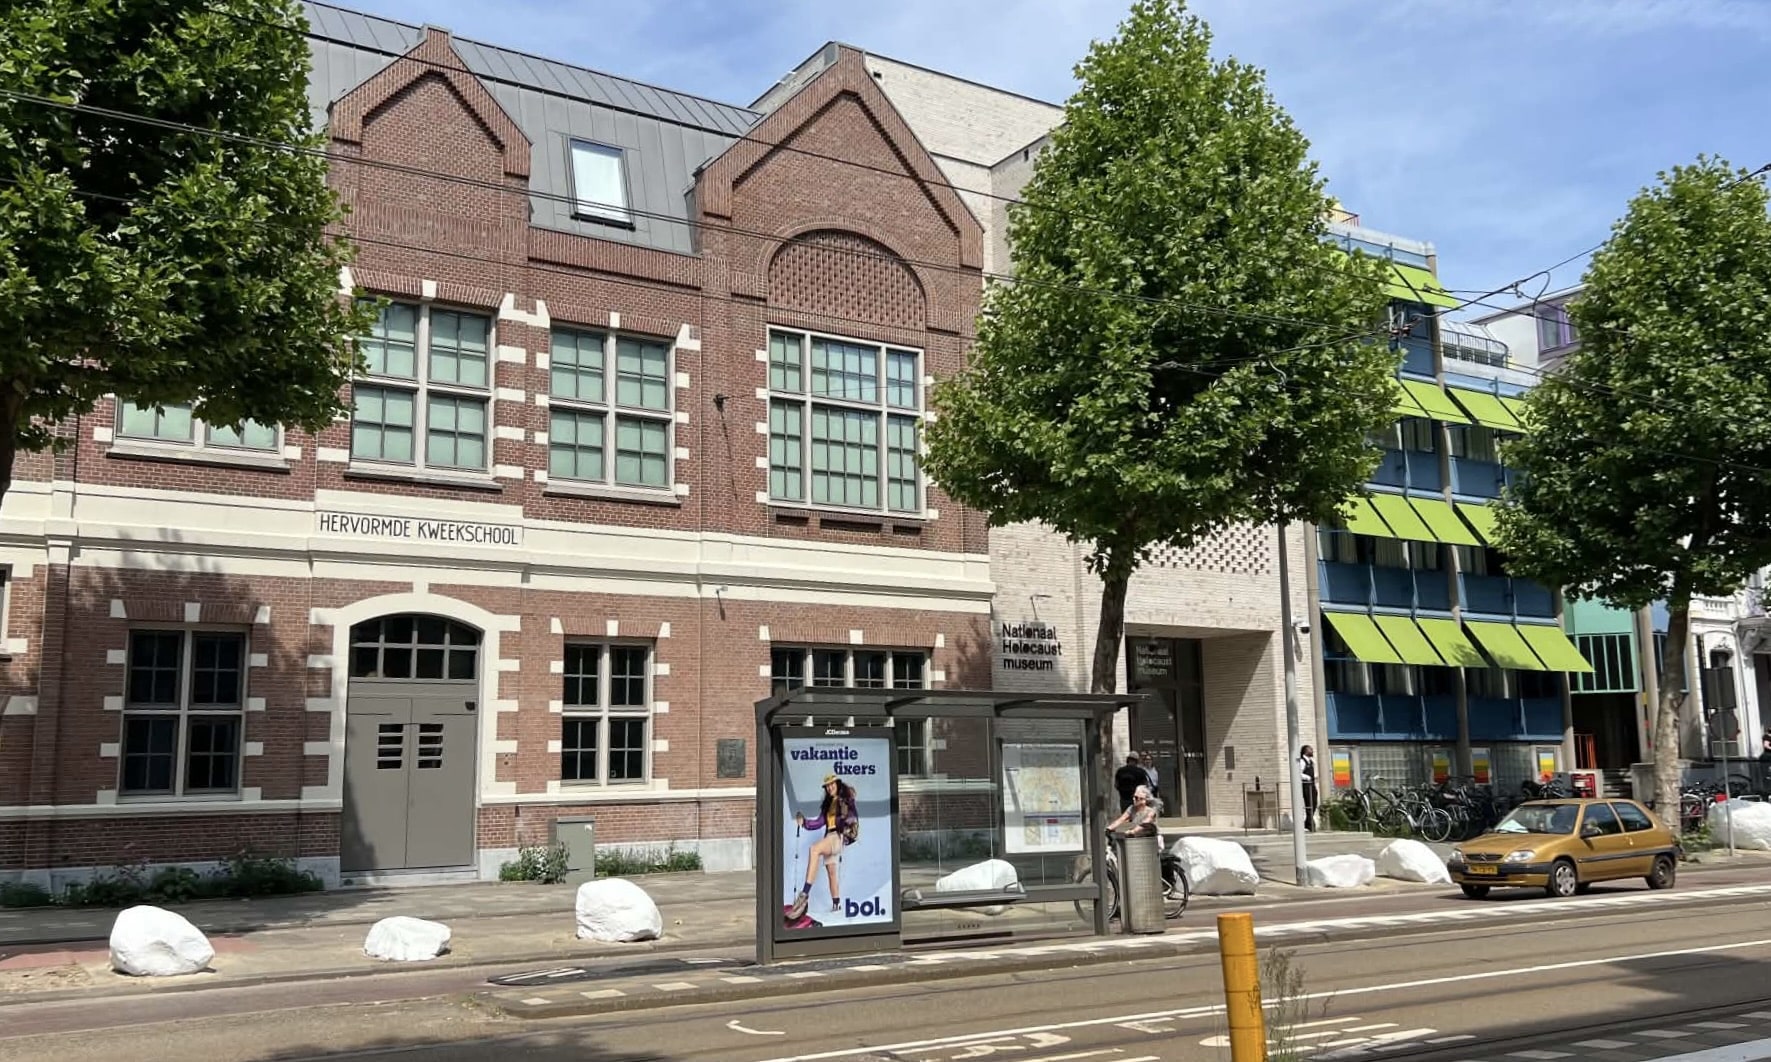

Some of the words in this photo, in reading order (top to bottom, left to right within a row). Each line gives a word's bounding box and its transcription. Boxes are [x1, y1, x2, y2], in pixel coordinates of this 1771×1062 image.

[320, 514, 411, 538] HERVORMDE
[417, 521, 519, 545] KWEEKSCHOOL
[1002, 622, 1057, 640] Nationaal
[1002, 639, 1062, 656] Holocaust
[1003, 658, 1053, 672] museum
[790, 746, 859, 761] vakantie
[833, 761, 876, 775] fixers
[845, 896, 886, 918] bol.
